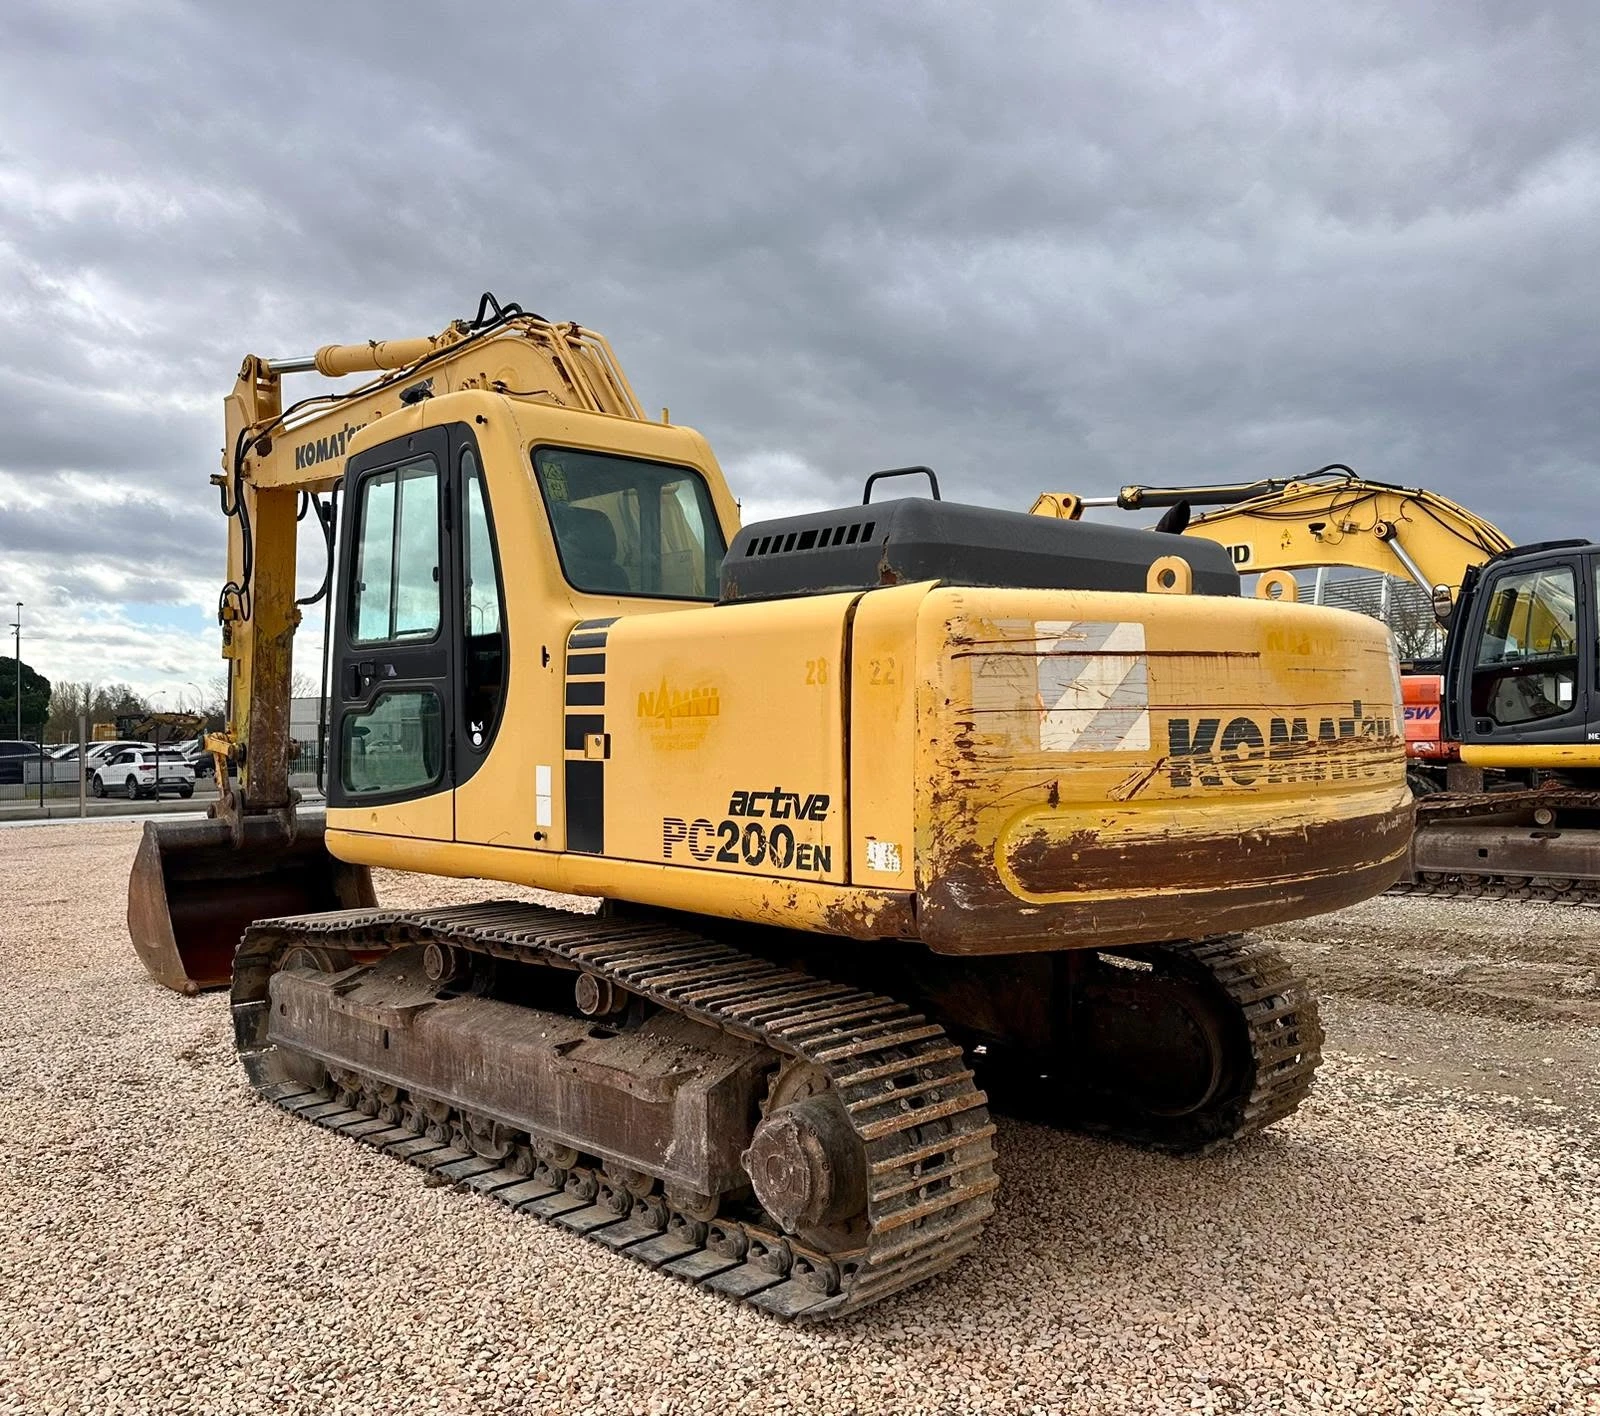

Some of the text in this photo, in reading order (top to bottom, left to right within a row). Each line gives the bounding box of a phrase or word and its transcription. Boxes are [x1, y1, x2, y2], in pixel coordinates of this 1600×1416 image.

[295, 422, 367, 470] KOMAT
[805, 656, 828, 685] 28
[728, 786, 830, 821] active
